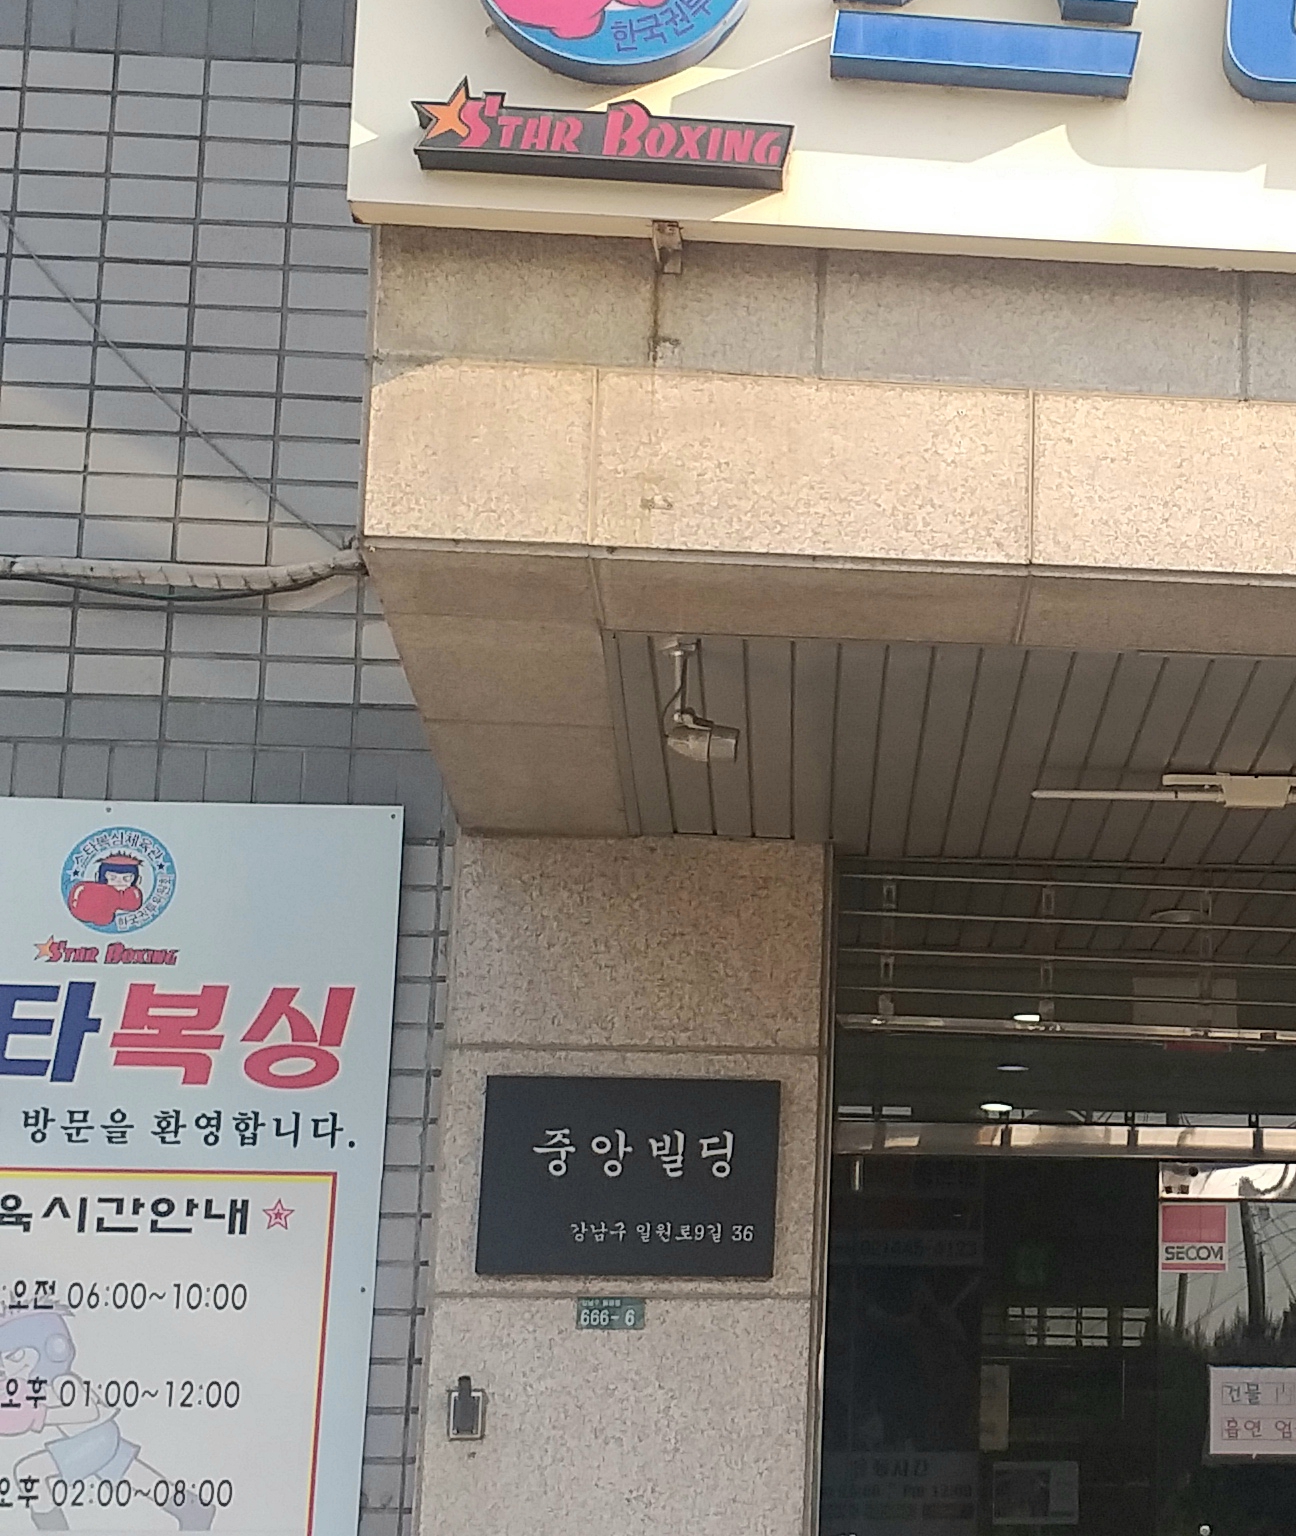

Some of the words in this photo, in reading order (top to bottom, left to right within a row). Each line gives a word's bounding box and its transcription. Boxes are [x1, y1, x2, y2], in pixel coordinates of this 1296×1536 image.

[22, 1107, 135, 1145] 방문을
[151, 1109, 356, 1149] 환영합니다.
[532, 1128, 736, 1179] 중앙빌딩
[570, 1220, 627, 1243] 강남구
[731, 1225, 755, 1242] 36
[1164, 1245, 1224, 1261] SECOM
[0, 1376, 48, 1409] 오후
[1224, 1418, 1262, 1440] 흡연
